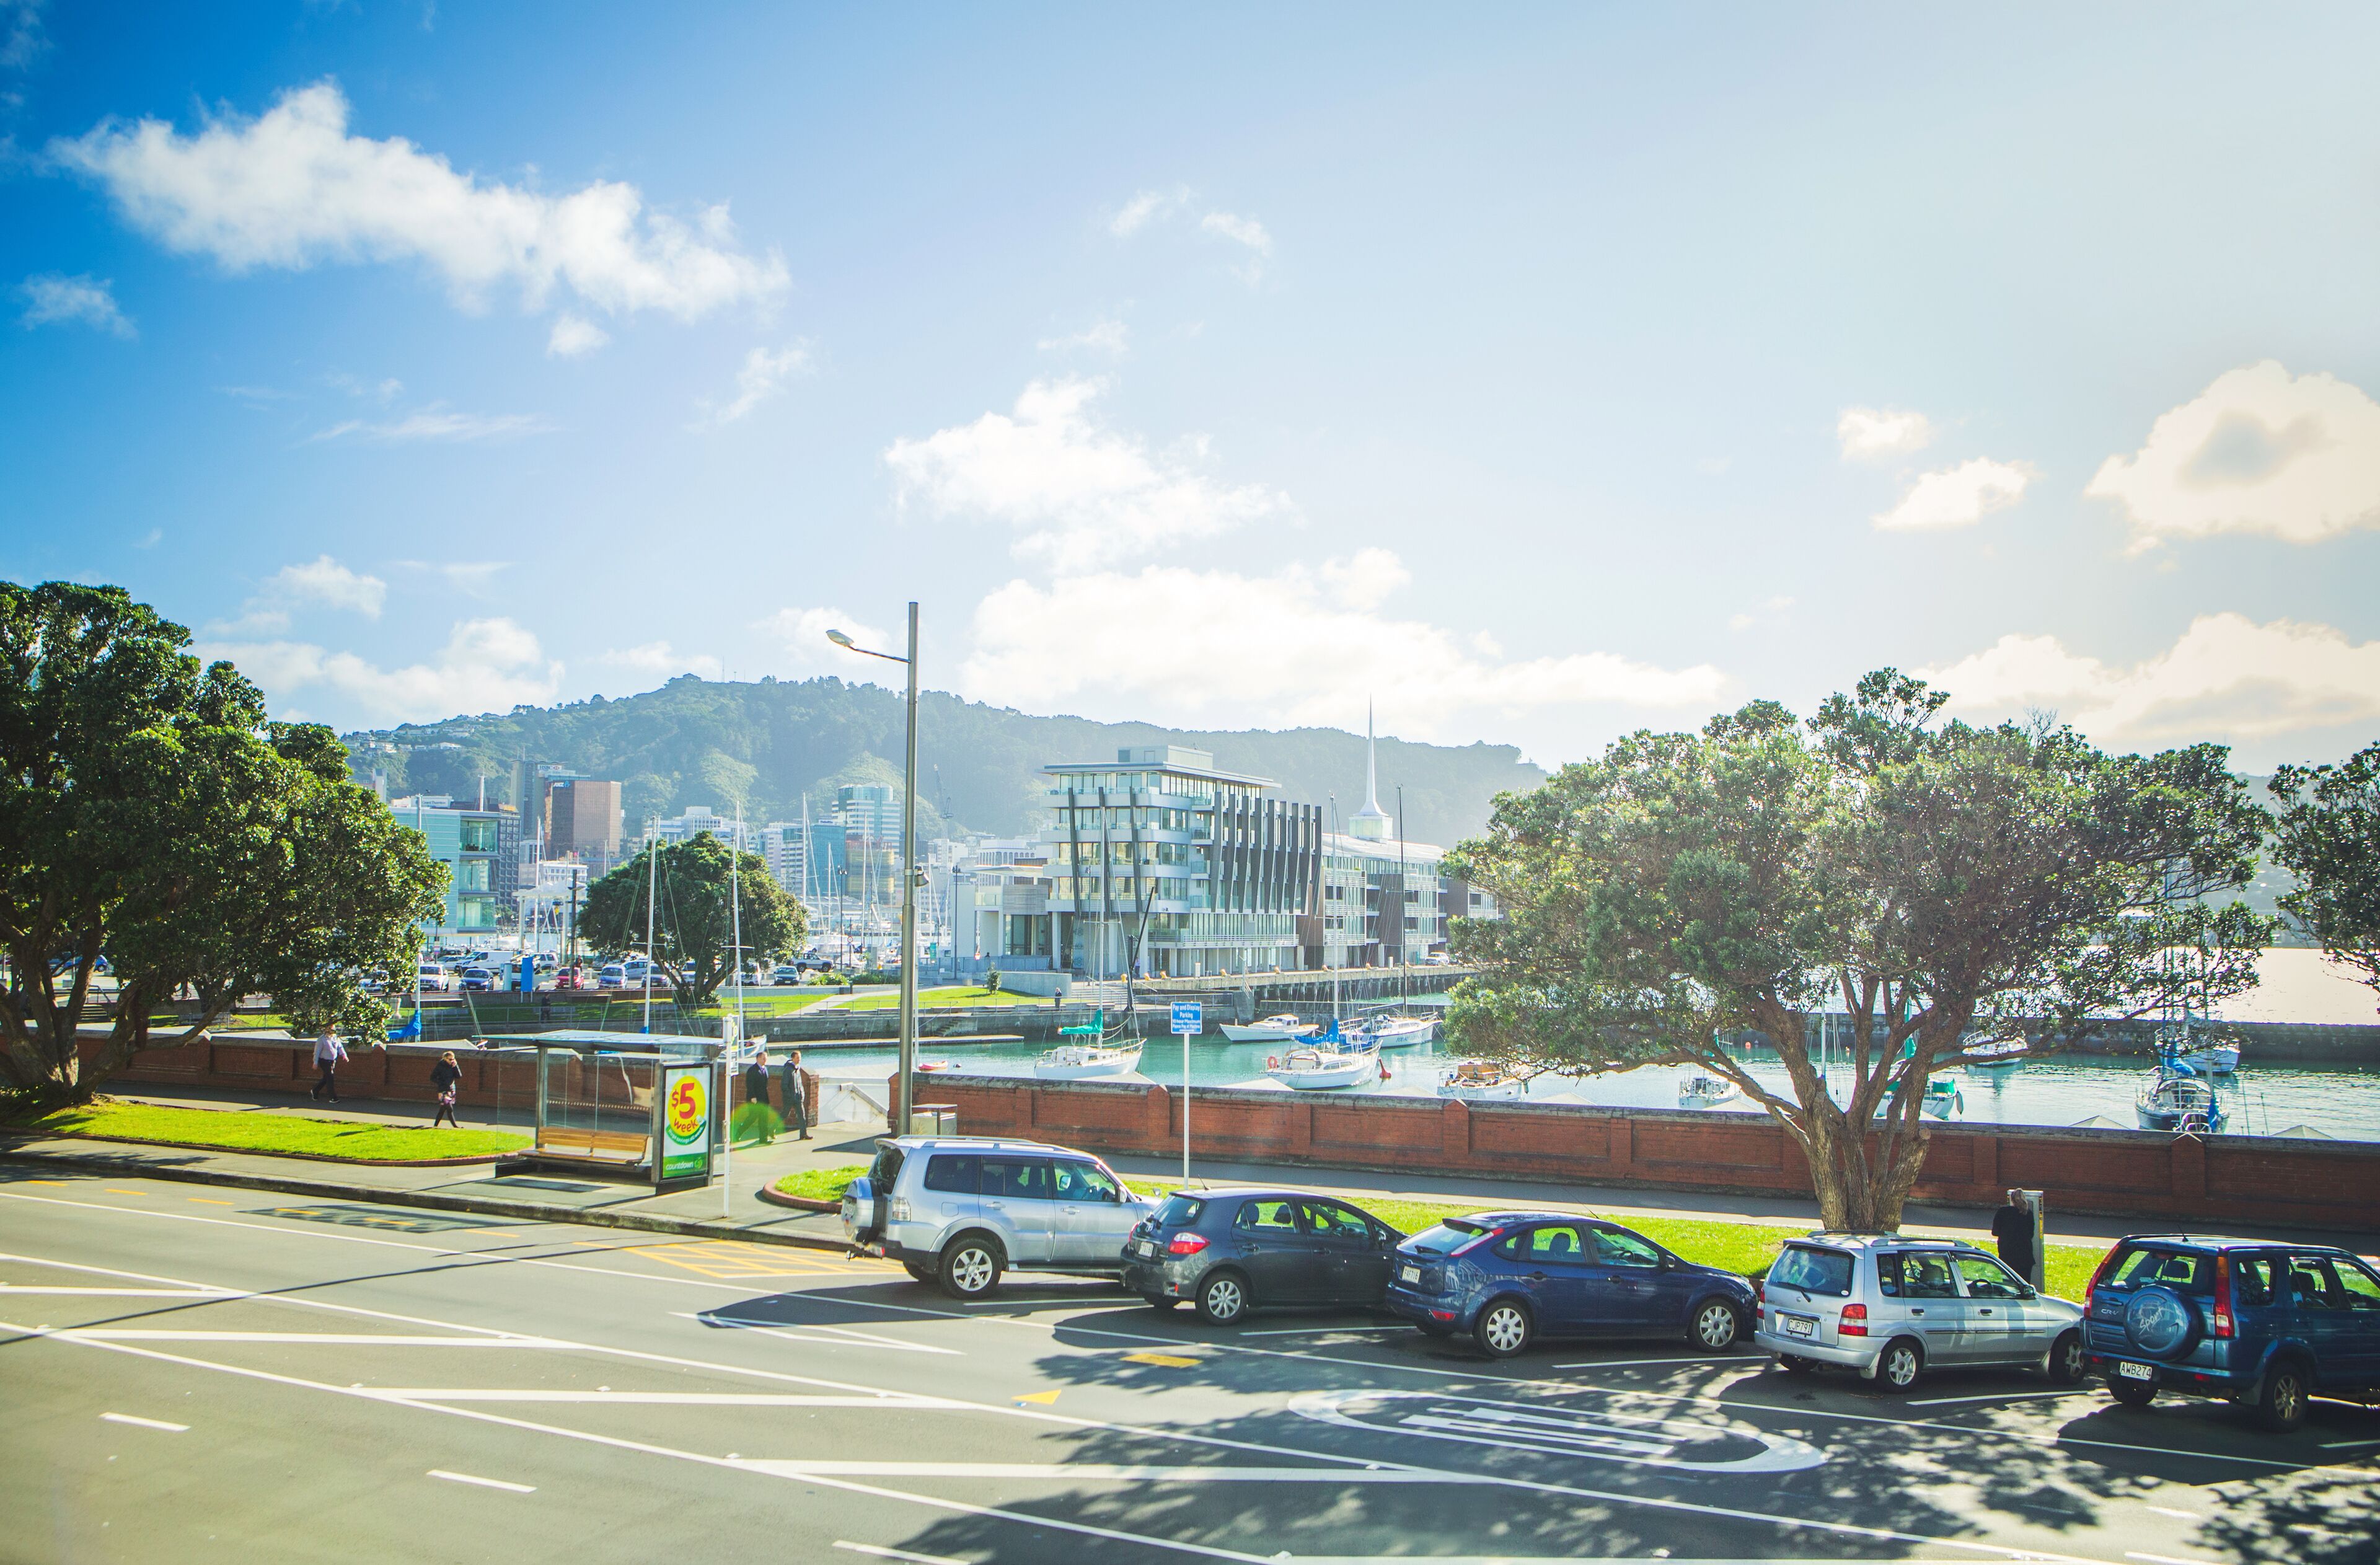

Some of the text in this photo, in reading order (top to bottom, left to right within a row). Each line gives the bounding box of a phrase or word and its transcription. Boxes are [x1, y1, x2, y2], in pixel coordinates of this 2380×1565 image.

[671, 1082, 696, 1119] $5
[674, 1118, 698, 1132] week
[666, 1162, 694, 1170] countdown
[1788, 1320, 1811, 1333] CJP791
[2121, 1364, 2151, 1377] AWB274
